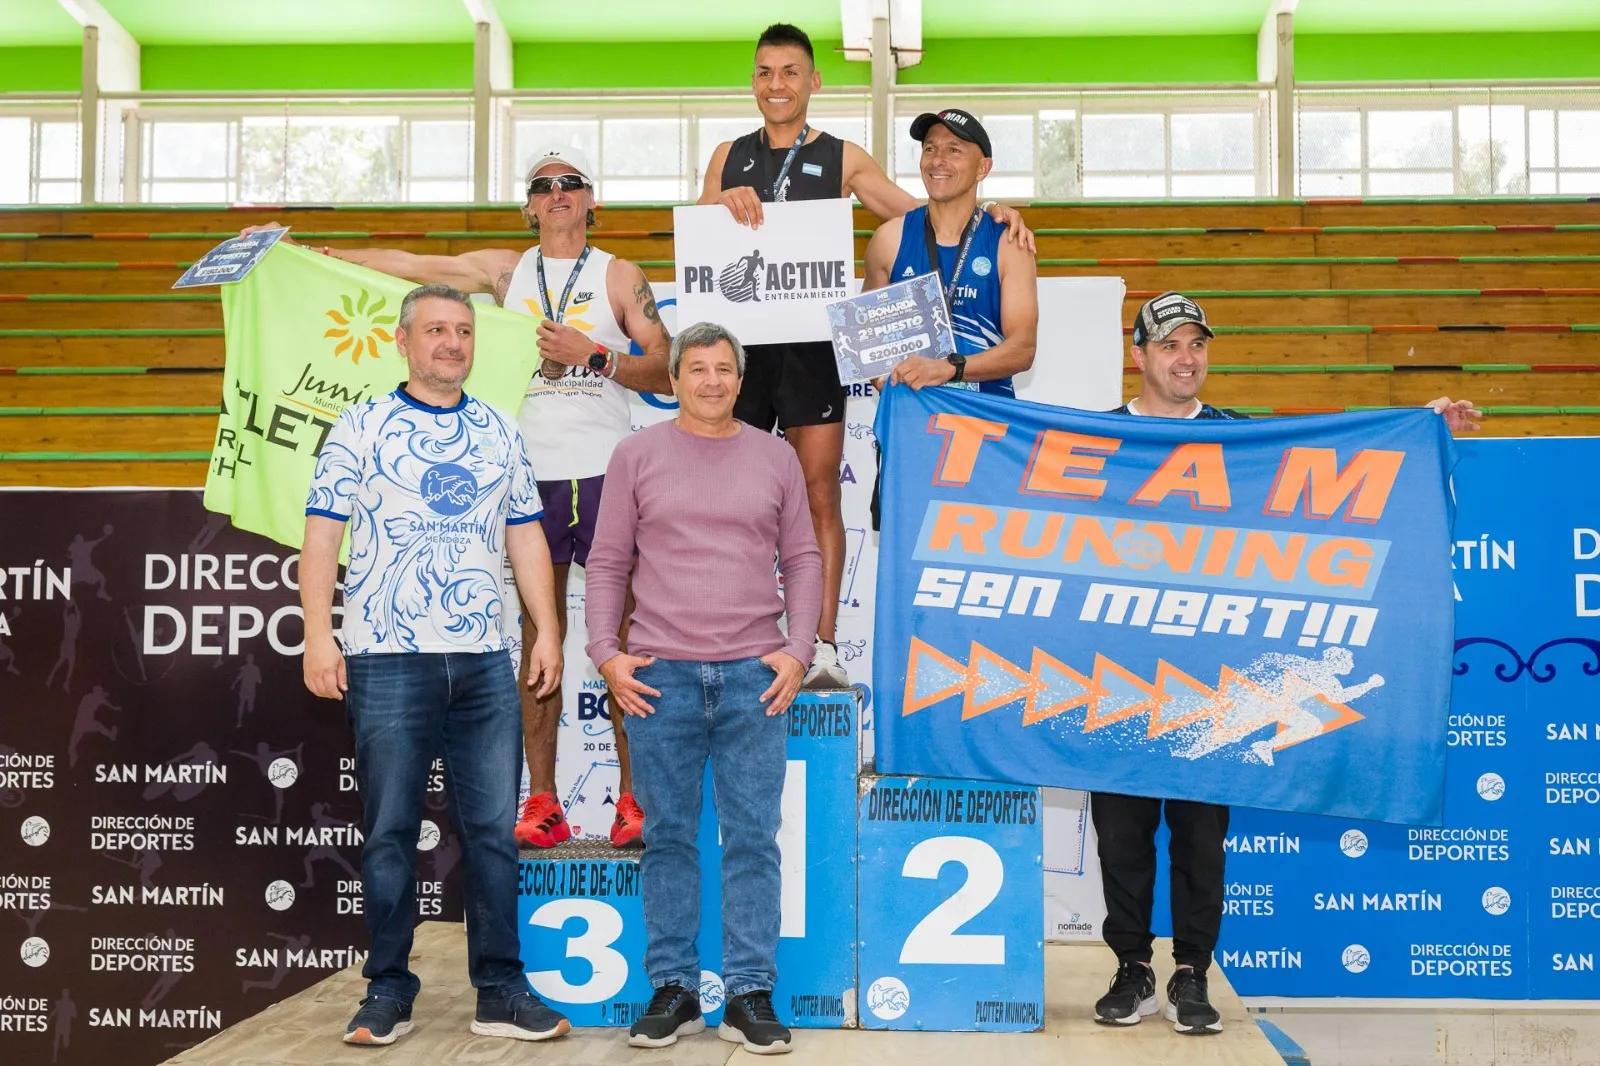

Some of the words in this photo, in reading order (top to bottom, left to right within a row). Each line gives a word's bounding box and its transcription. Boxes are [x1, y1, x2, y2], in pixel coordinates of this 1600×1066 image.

[577, 291, 594, 300] NIKE
[765, 290, 847, 301] ENTRENAMIENTO
[868, 299, 918, 320] BONARDA
[874, 315, 924, 337] PUESTO
[869, 339, 924, 361] $200.000
[543, 379, 604, 389] Municipalidad
[927, 412, 1406, 523] TEAM
[409, 520, 436, 532] SAN
[440, 520, 487, 535] MARTÍN
[425, 536, 472, 545] MENDOZA
[928, 503, 1375, 587] RUNNING
[913, 567, 1062, 618] SAN
[1487, 715, 1506, 727] DE
[1546, 723, 1588, 741] SAN
[584, 743, 595, 752] 20
[598, 743, 611, 752] DE
[35, 755, 55, 768] DE
[95, 763, 137, 783] SAN
[145, 760, 227, 784] MARTÍN
[868, 782, 942, 822] DIRECCIÓN
[945, 789, 963, 824] DE
[966, 790, 1037, 826] DEPORTES
[91, 814, 172, 830] DIRECCIÓN
[175, 817, 195, 830] DE
[91, 832, 195, 851] DEPORTES
[235, 826, 278, 846] SAN
[1222, 832, 1300, 854] MARTÍN
[1408, 827, 1487, 842] DIRECCIÓN
[1490, 829, 1509, 842] DE
[1408, 844, 1510, 861] DEPORTES
[1549, 837, 1591, 856] SAN
[32, 876, 51, 889] DE
[569, 862, 587, 897] DE
[92, 885, 134, 905] SAN
[142, 882, 224, 906] MARTÍN
[1255, 884, 1274, 896] DE
[899, 835, 1006, 965] 2
[1314, 892, 1355, 911] SAN
[1362, 889, 1442, 911] MARTÍN
[1057, 922, 1093, 931] nomade
[91, 935, 172, 951] DIRECCIÓN
[175, 938, 195, 951] DE
[525, 898, 629, 1005] 3
[1410, 942, 1489, 957] DIRECCIÓN
[1492, 944, 1512, 957] DE
[91, 954, 195, 973] DEPORTES
[235, 948, 278, 967] SAN
[286, 945, 369, 969] MARTÍN
[1223, 946, 1302, 969] MARTÍN
[1552, 953, 1594, 972] SAN
[1411, 960, 1513, 977] DEPORTES
[28, 998, 48, 1011] DE
[790, 994, 819, 1017] PLOTTER
[975, 999, 1003, 1024] PLOTTER
[1004, 1001, 1040, 1025] MUNICIPAL
[89, 1007, 131, 1027] SAN
[139, 1005, 221, 1029] MARTÍN
